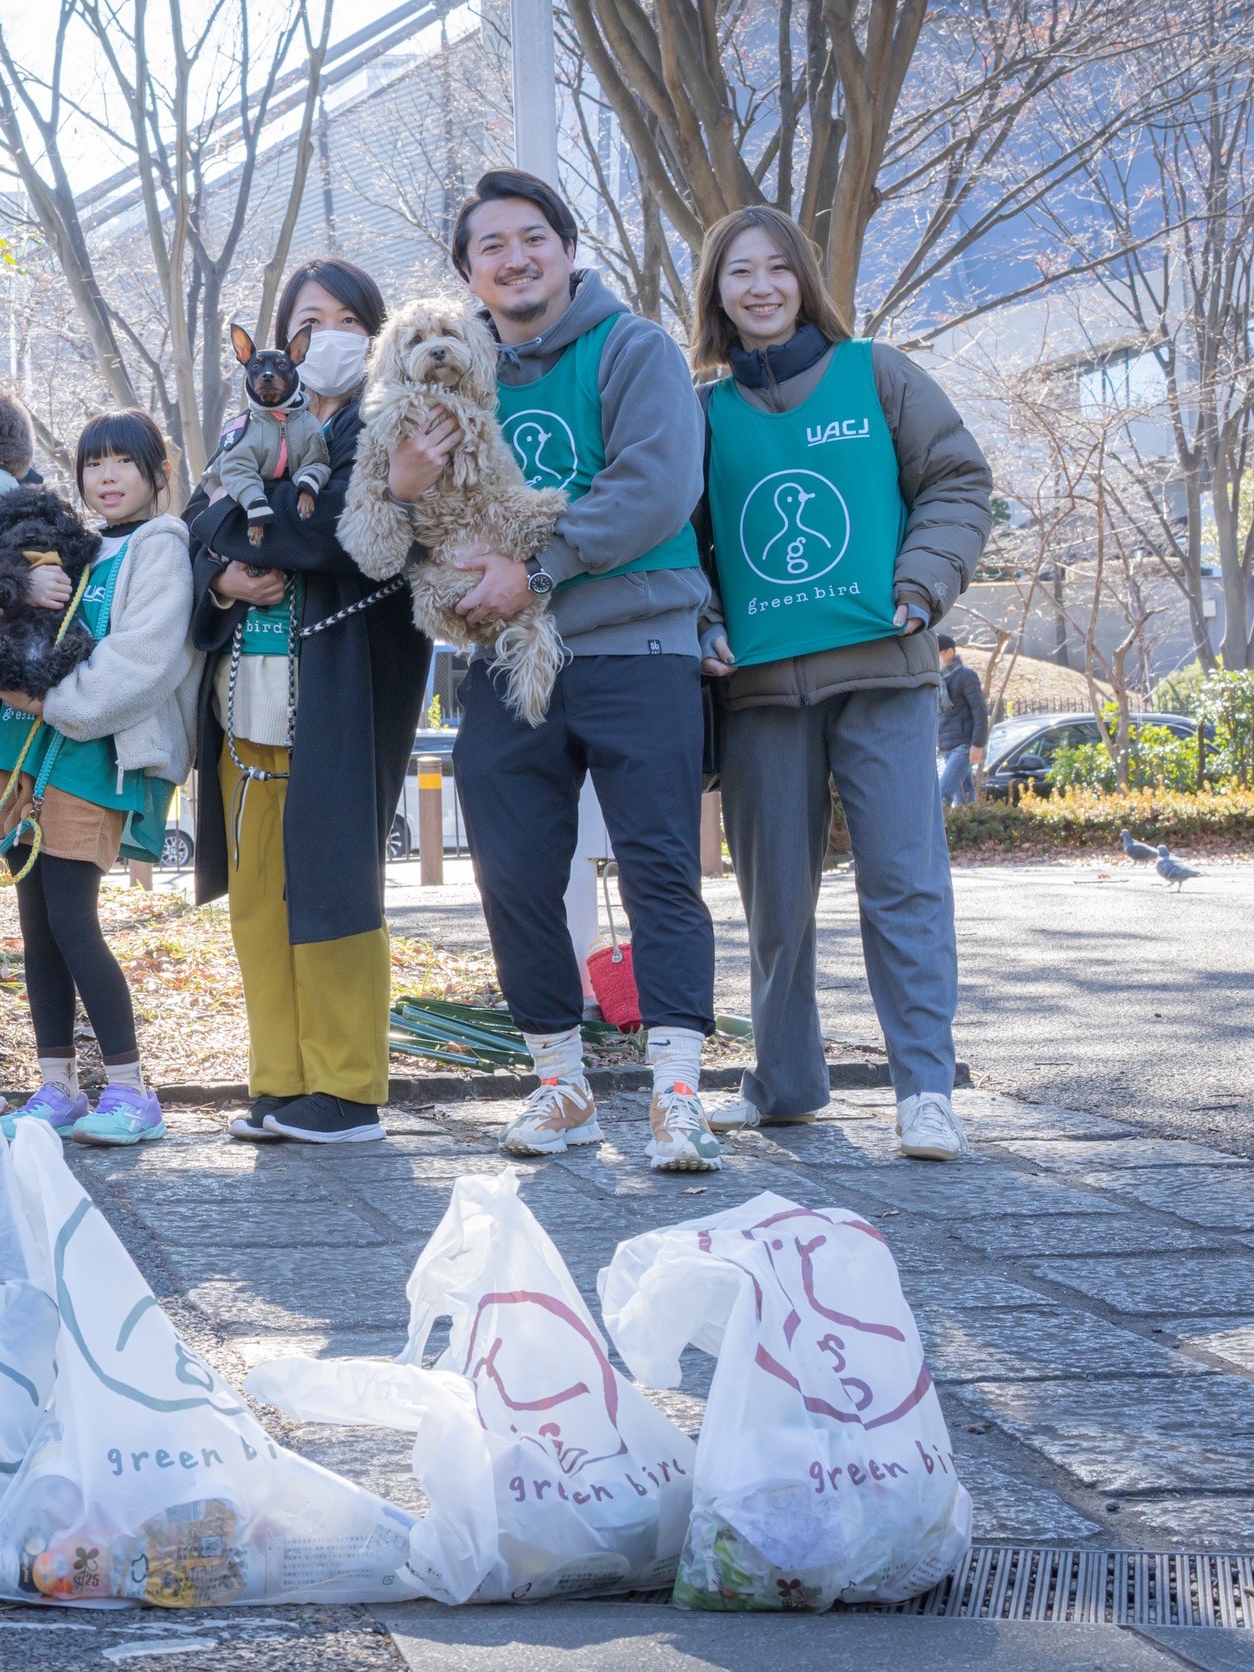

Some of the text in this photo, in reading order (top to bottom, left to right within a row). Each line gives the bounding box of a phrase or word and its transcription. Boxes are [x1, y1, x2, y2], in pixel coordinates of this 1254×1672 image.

[806, 418, 870, 446] UACJ
[748, 582, 861, 615] green bird
[246, 620, 284, 634] bird
[107, 1447, 225, 1476] green
[809, 1457, 909, 1494] green
